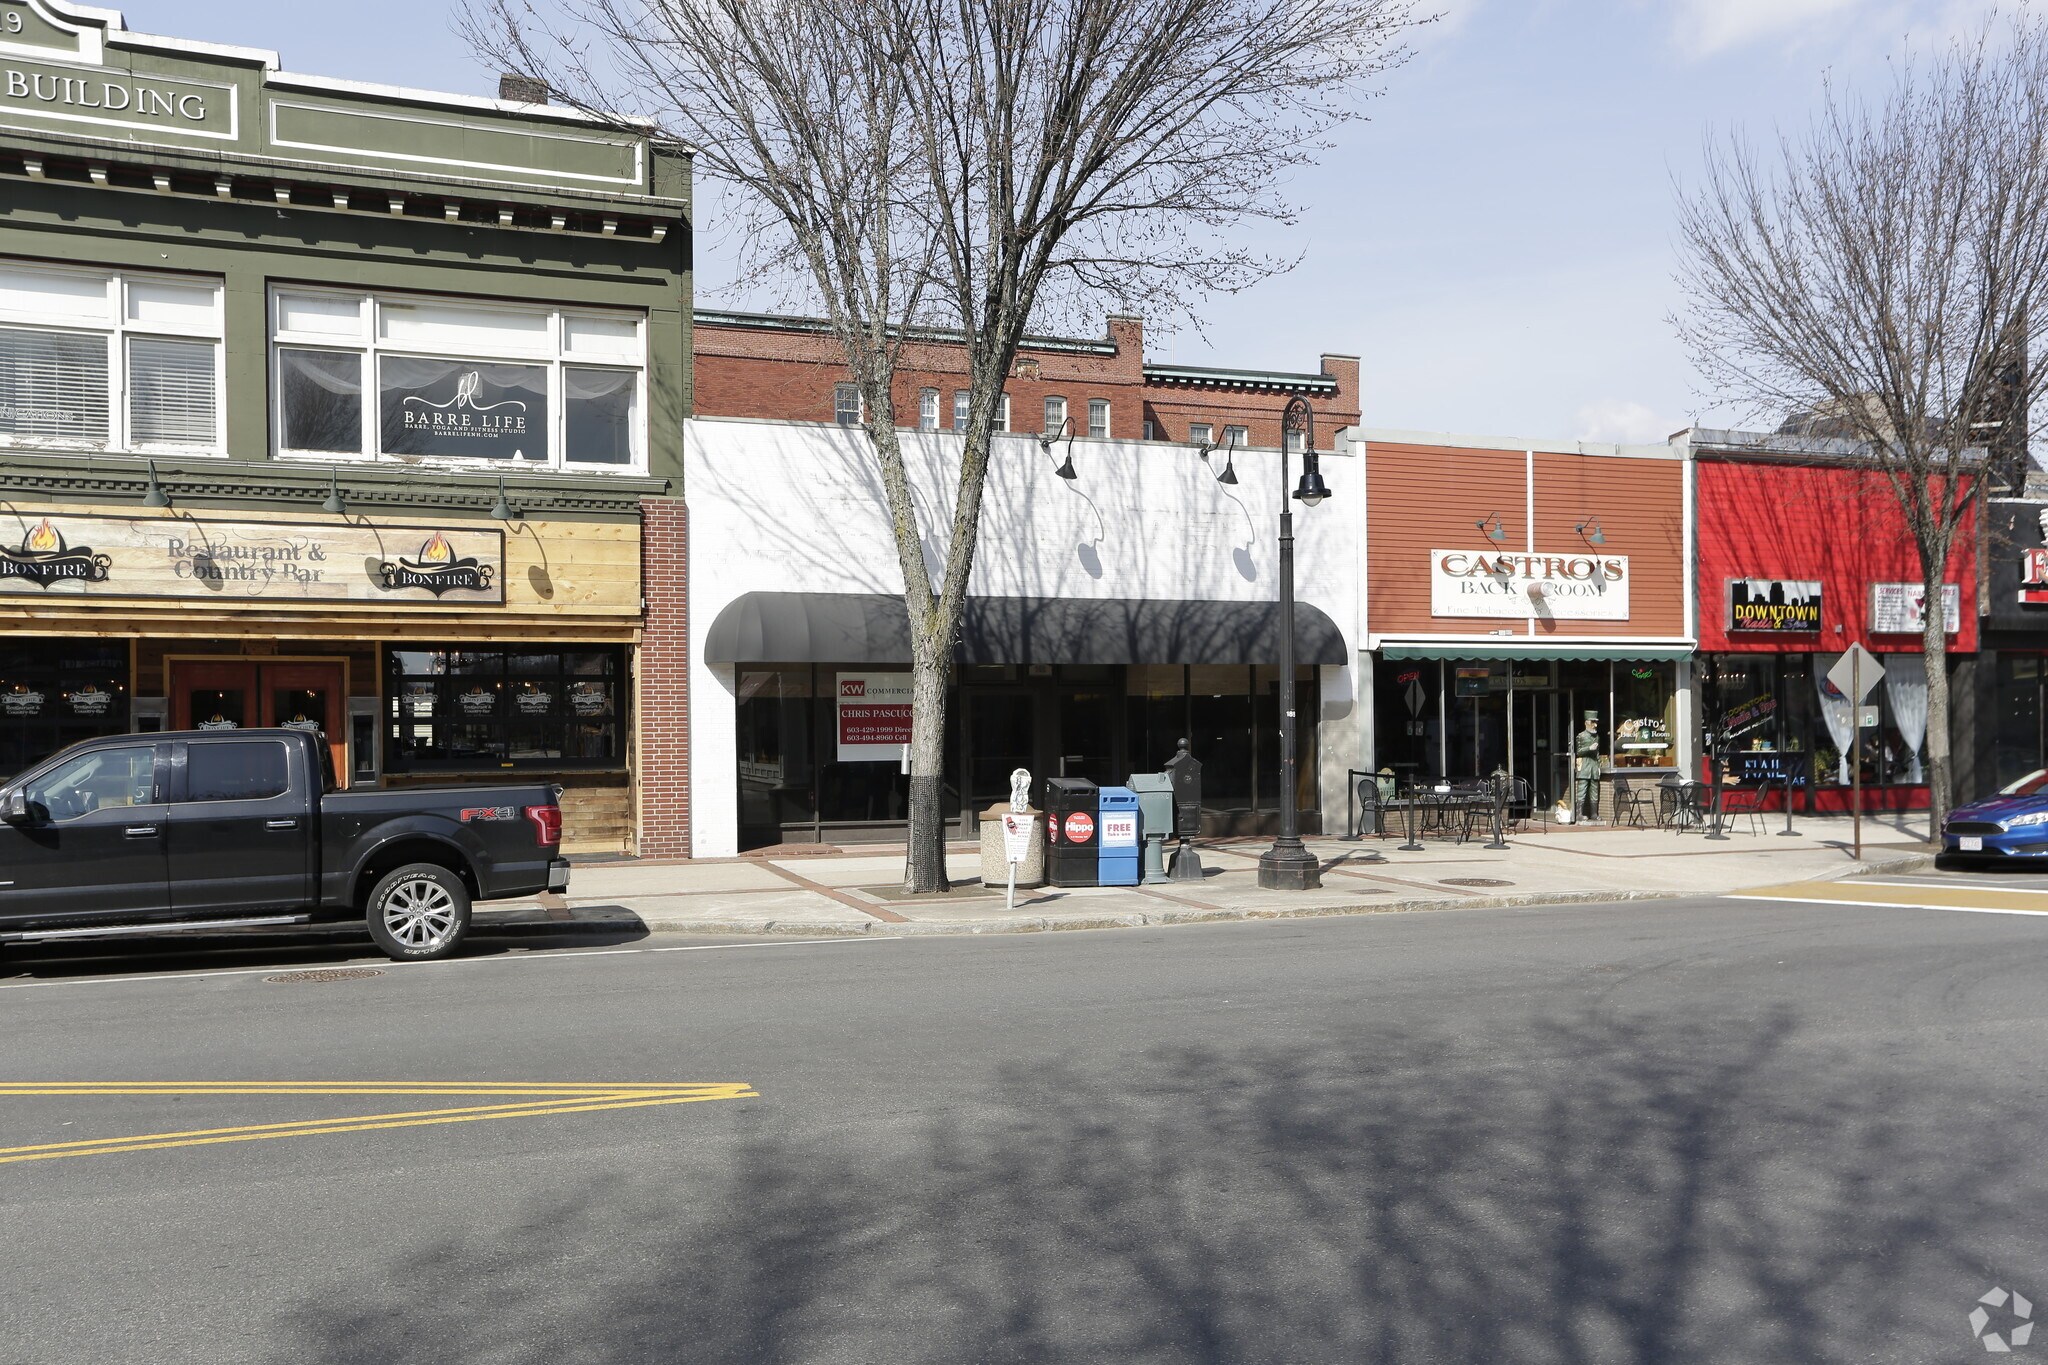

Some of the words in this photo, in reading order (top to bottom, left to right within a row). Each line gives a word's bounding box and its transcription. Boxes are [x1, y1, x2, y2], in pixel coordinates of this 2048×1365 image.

[0, 11, 23, 33] 9
[5, 69, 207, 121] BUILDING
[404, 411, 471, 426] BARRE
[482, 415, 526, 429] LIFE
[167, 537, 302, 561] Restaurant
[307, 542, 328, 562] &
[2, 560, 87, 577] BONFIRE
[174, 559, 276, 586] Country
[282, 562, 325, 583] Bar
[1440, 554, 1624, 582] CASTRO'S
[402, 572, 473, 586] BONFIRE
[1461, 581, 1518, 595] BACK
[1447, 605, 1470, 614] Fine
[1474, 605, 1528, 615] Tobaccos
[1735, 604, 1818, 621] DOWNTOWN
[1740, 615, 1773, 629] Nails
[1773, 616, 1782, 629] &
[1782, 618, 1808, 630] Spa
[841, 684, 864, 695] KW
[841, 709, 871, 718] CHRIS
[1623, 716, 1666, 732] Castro's
[1745, 759, 1787, 779] NAIL
[461, 806, 515, 822] FX4
[1065, 821, 1094, 833] Hippo
[1107, 824, 1131, 832] FREE
[377, 873, 436, 909] GOODYEAR
